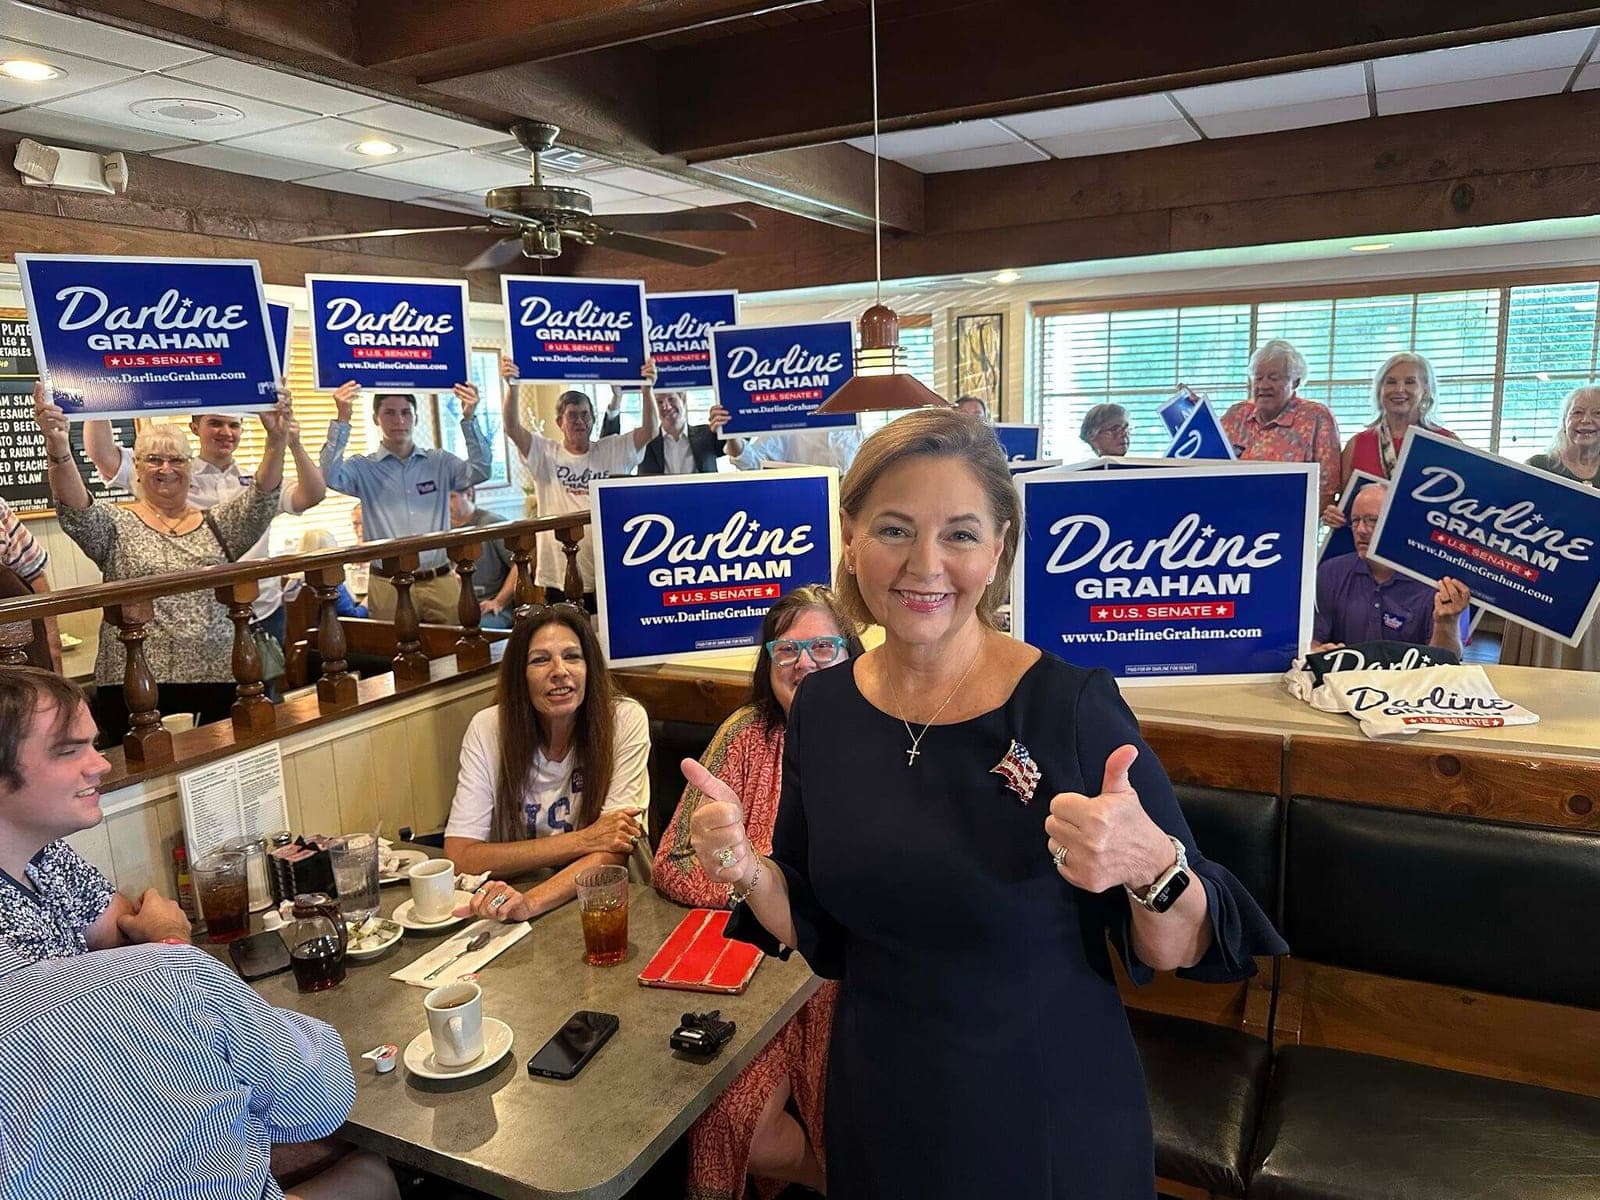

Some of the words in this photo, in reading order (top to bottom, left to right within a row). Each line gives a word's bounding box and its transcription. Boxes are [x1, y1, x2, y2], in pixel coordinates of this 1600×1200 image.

[55, 285, 249, 331] Darline
[520, 296, 634, 329] Darline
[327, 297, 454, 334] Darline
[2, 323, 32, 336] PLATE
[536, 328, 620, 342] GRAHAM
[2, 337, 17, 346] LEG
[20, 338, 27, 346] &
[87, 332, 230, 351] GRAHAM
[344, 332, 439, 347] GRAHAM
[384, 350, 420, 358] SENATE
[555, 343, 569, 351] U.S.
[571, 344, 603, 352] SENATE
[123, 355, 150, 366] U.S.
[152, 355, 204, 366] SENATE
[338, 360, 448, 371] www.DarlineGraham.com
[531, 354, 628, 363] www.DarlineGraham.com
[671, 354, 701, 363] SENATE
[727, 344, 844, 379] Darline
[86, 370, 246, 384] www.DarlineGraham.com
[743, 374, 829, 391] GRAHAM
[762, 394, 778, 402] U.S.
[779, 392, 812, 401] SENATE
[13, 421, 41, 432] BEETS
[16, 434, 45, 446] SALAD
[9, 446, 35, 459] RAISIN
[37, 446, 48, 457] SA
[14, 459, 48, 472] PEACHE
[17, 471, 42, 485] SLAW
[1412, 466, 1595, 562] Darline
[622, 511, 815, 566] Darline
[1046, 513, 1282, 574] Darline
[1426, 510, 1560, 573] GRAHAM
[1447, 538, 1470, 553] U.S.
[1471, 546, 1522, 575] SENATE
[649, 559, 792, 587] GRAHAM
[1408, 536, 1554, 604] www.DarlineGraham.com
[1075, 573, 1251, 599] GRAHAM
[681, 593, 707, 602] U.S.
[709, 587, 763, 600] SENATE
[1112, 608, 1143, 618] U.S.
[1147, 605, 1212, 617] SENATE
[1061, 626, 1262, 643] www.DarlineGraham.com
[1346, 686, 1514, 712] Darline
[1419, 717, 1442, 725] U.S.
[1446, 717, 1490, 727] SENATE
